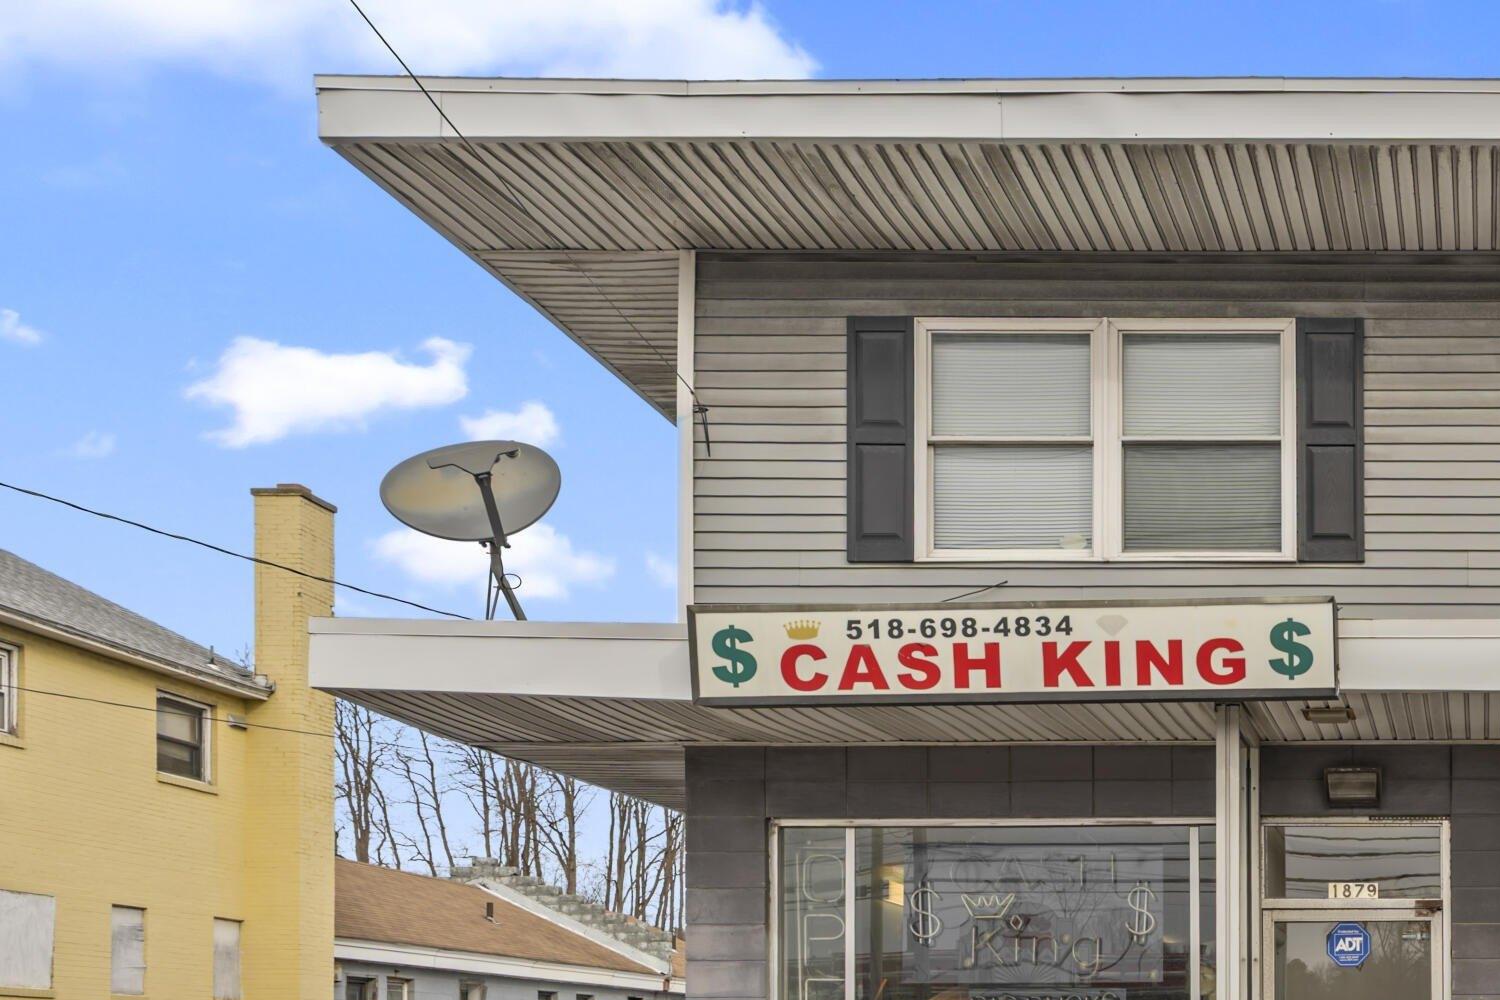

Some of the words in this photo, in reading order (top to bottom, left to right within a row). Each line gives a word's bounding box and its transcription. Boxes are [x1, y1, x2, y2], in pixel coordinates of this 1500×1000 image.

[845, 615, 1073, 640] 518-698-4834
[780, 641, 1003, 692] CASH
[1041, 637, 1247, 688] KING
[1331, 883, 1378, 899] 1879
[1335, 937, 1364, 952] ADT
